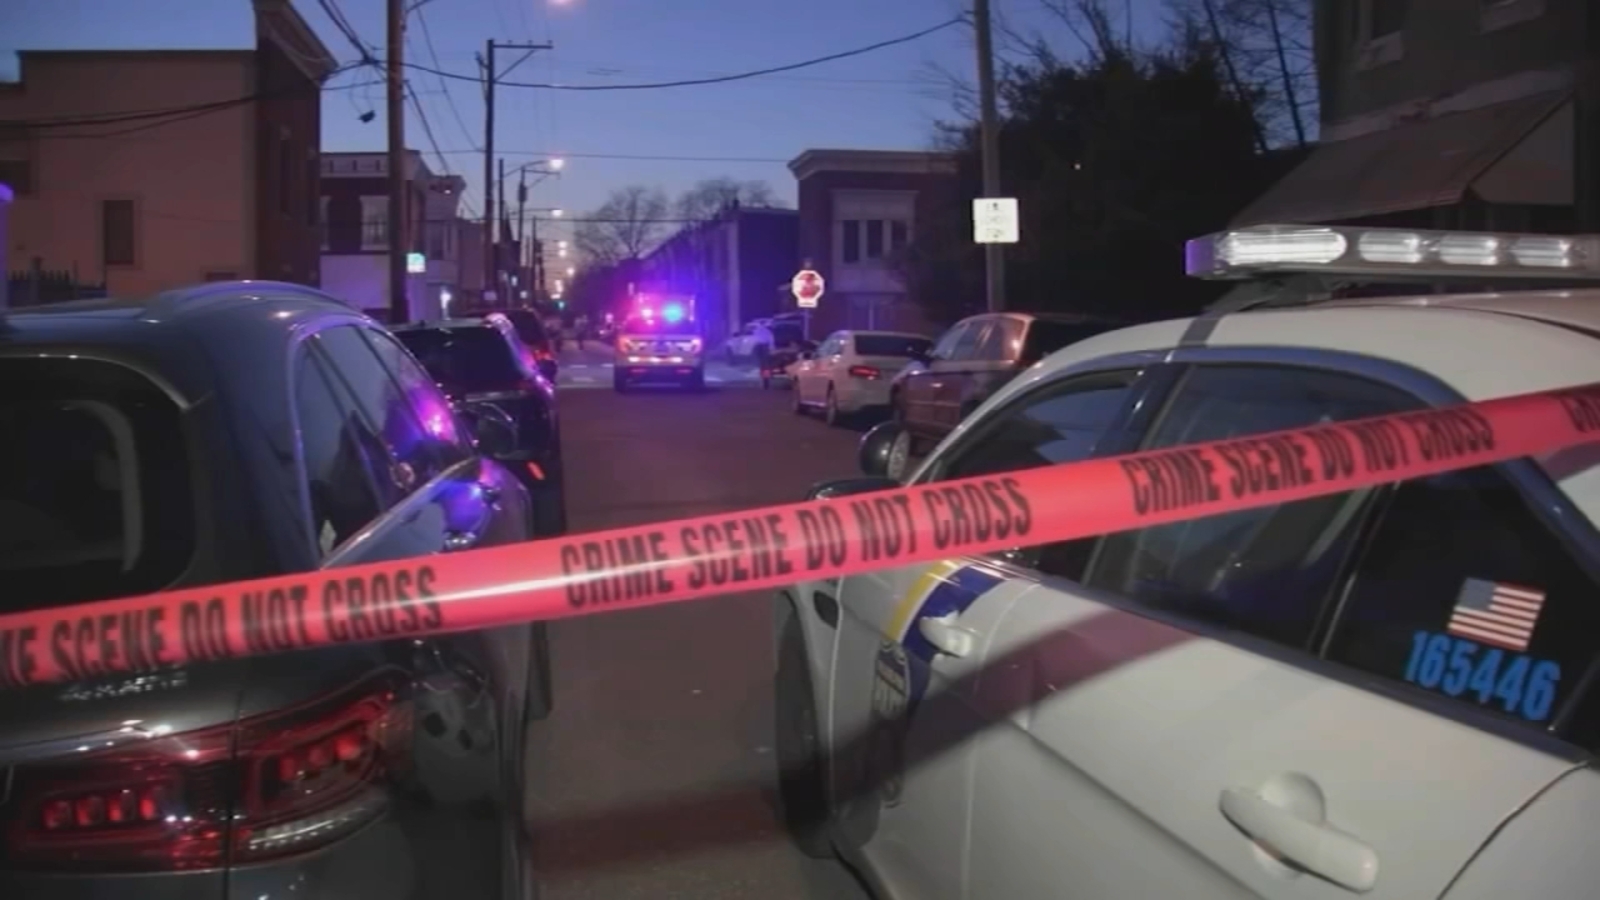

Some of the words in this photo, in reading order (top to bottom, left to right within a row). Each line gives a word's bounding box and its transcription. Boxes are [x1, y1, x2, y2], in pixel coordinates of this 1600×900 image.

[1119, 449, 1220, 515] CRIME
[1213, 433, 1313, 498] SCENE
[1300, 428, 1354, 481] DO
[1351, 420, 1409, 473] NOT
[1402, 408, 1494, 460] CROSS
[560, 532, 674, 608] CRIME
[680, 514, 792, 589] SCENE
[796, 506, 846, 570] DO
[851, 494, 916, 561] NOT
[922, 478, 1031, 549] CROSS
[52, 606, 164, 681] SCENE
[180, 597, 231, 661] DO
[241, 584, 308, 651] NOT
[323, 566, 441, 643] CROSS
[1405, 629, 1561, 721] 165446
